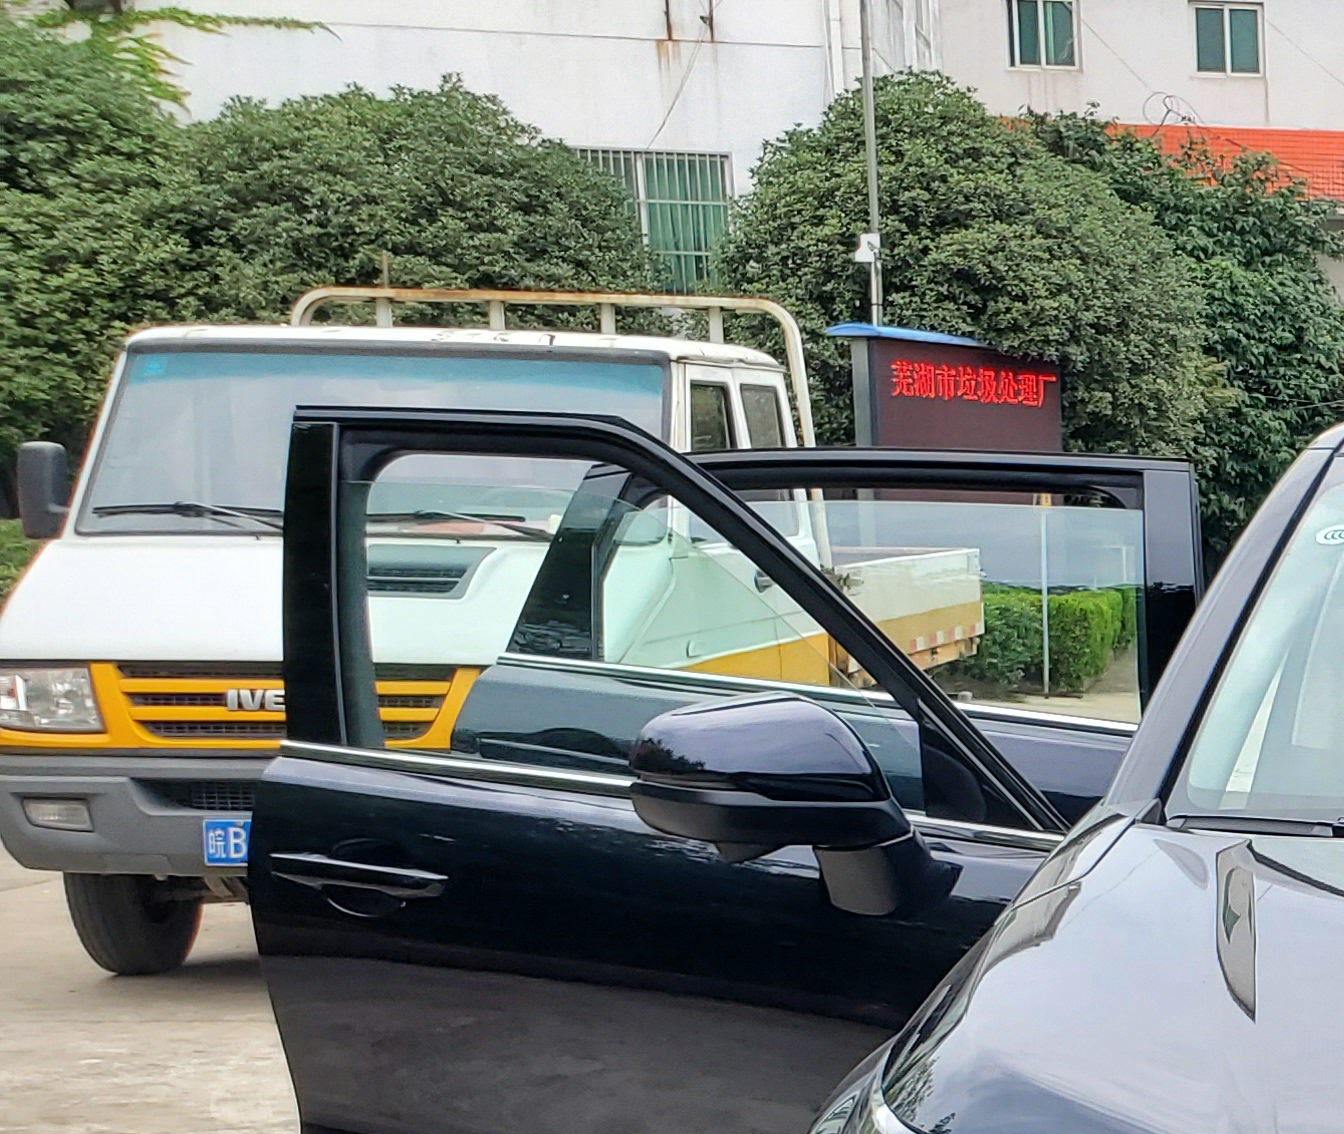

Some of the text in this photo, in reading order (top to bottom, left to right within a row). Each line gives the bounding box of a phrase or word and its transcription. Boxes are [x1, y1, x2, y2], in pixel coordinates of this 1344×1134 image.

[890, 359, 1057, 407] 芜湖市垃圾处理厂
